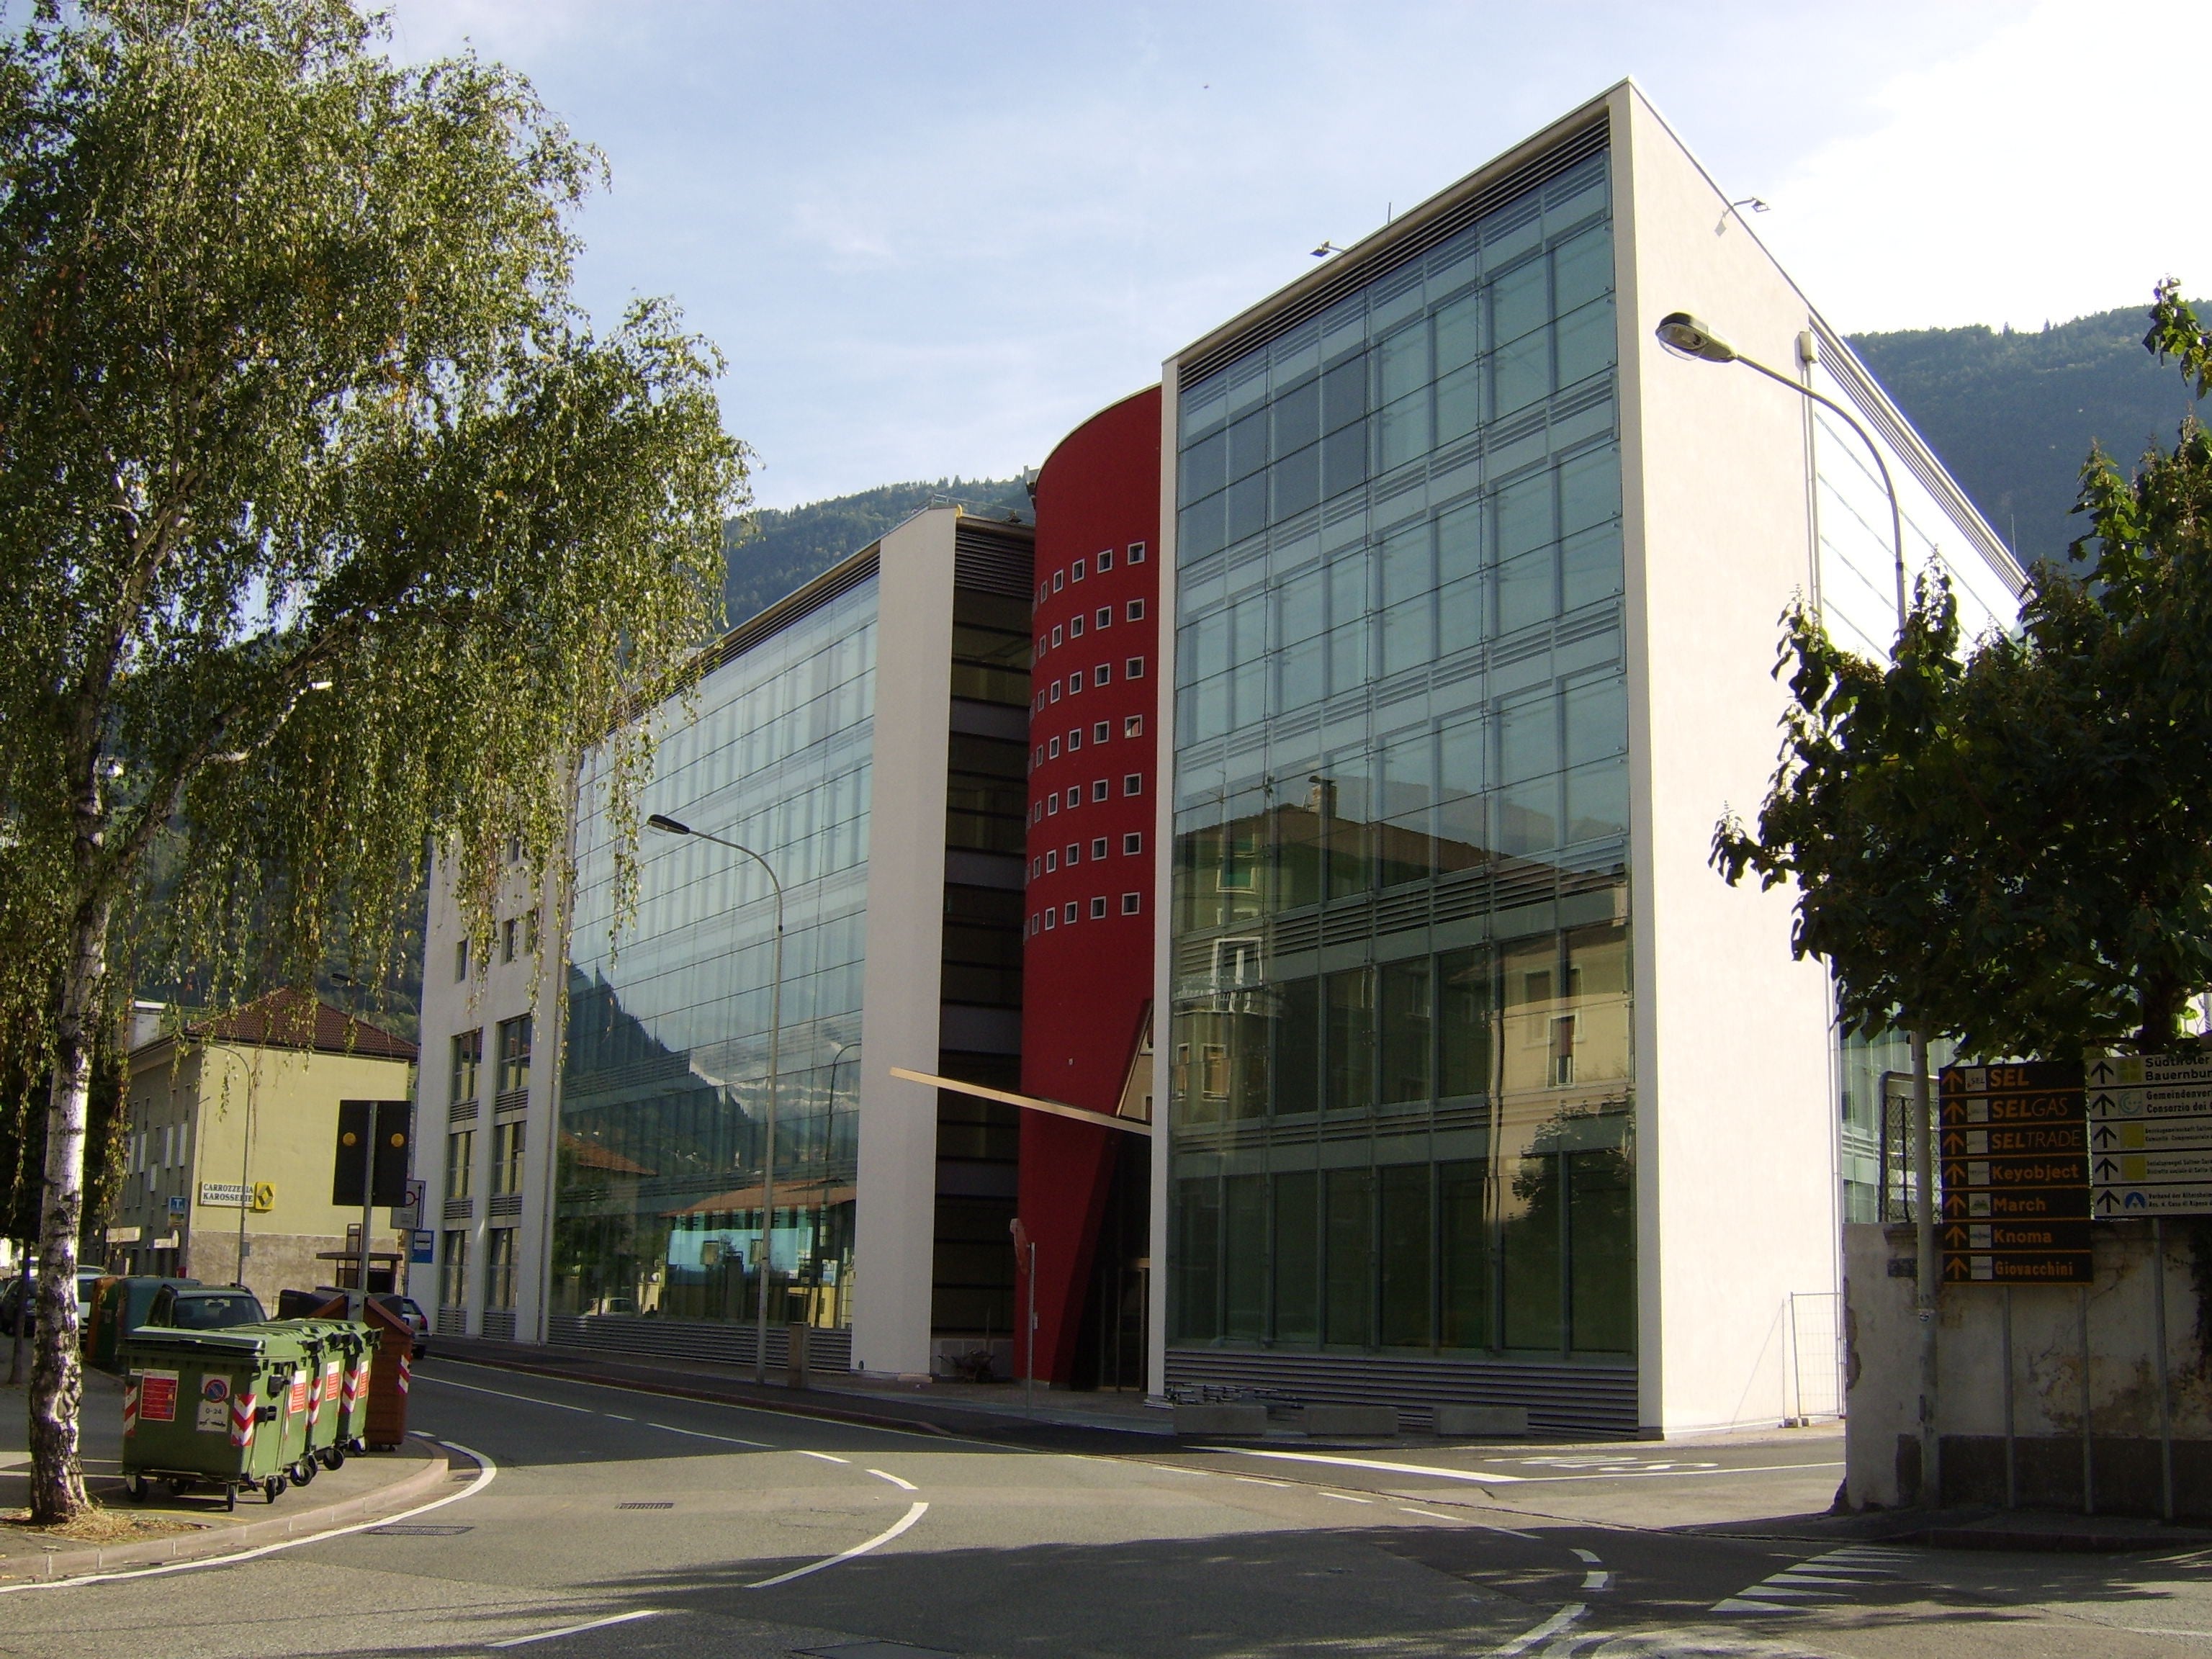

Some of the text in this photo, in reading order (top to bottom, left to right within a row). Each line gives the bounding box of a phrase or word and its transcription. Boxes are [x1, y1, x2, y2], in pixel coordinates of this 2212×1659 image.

[1990, 1068, 2030, 1087] SEL
[2146, 1102, 2190, 1113] Consorzio
[2193, 1101, 2206, 1111] dei
[1992, 1164, 2080, 1182] Keyobject
[203, 1183, 253, 1194] CARROZZEIA
[1993, 1196, 2047, 1212] March
[1993, 1228, 2053, 1244] Knoma
[1995, 1260, 2074, 1277] Giovacchini
